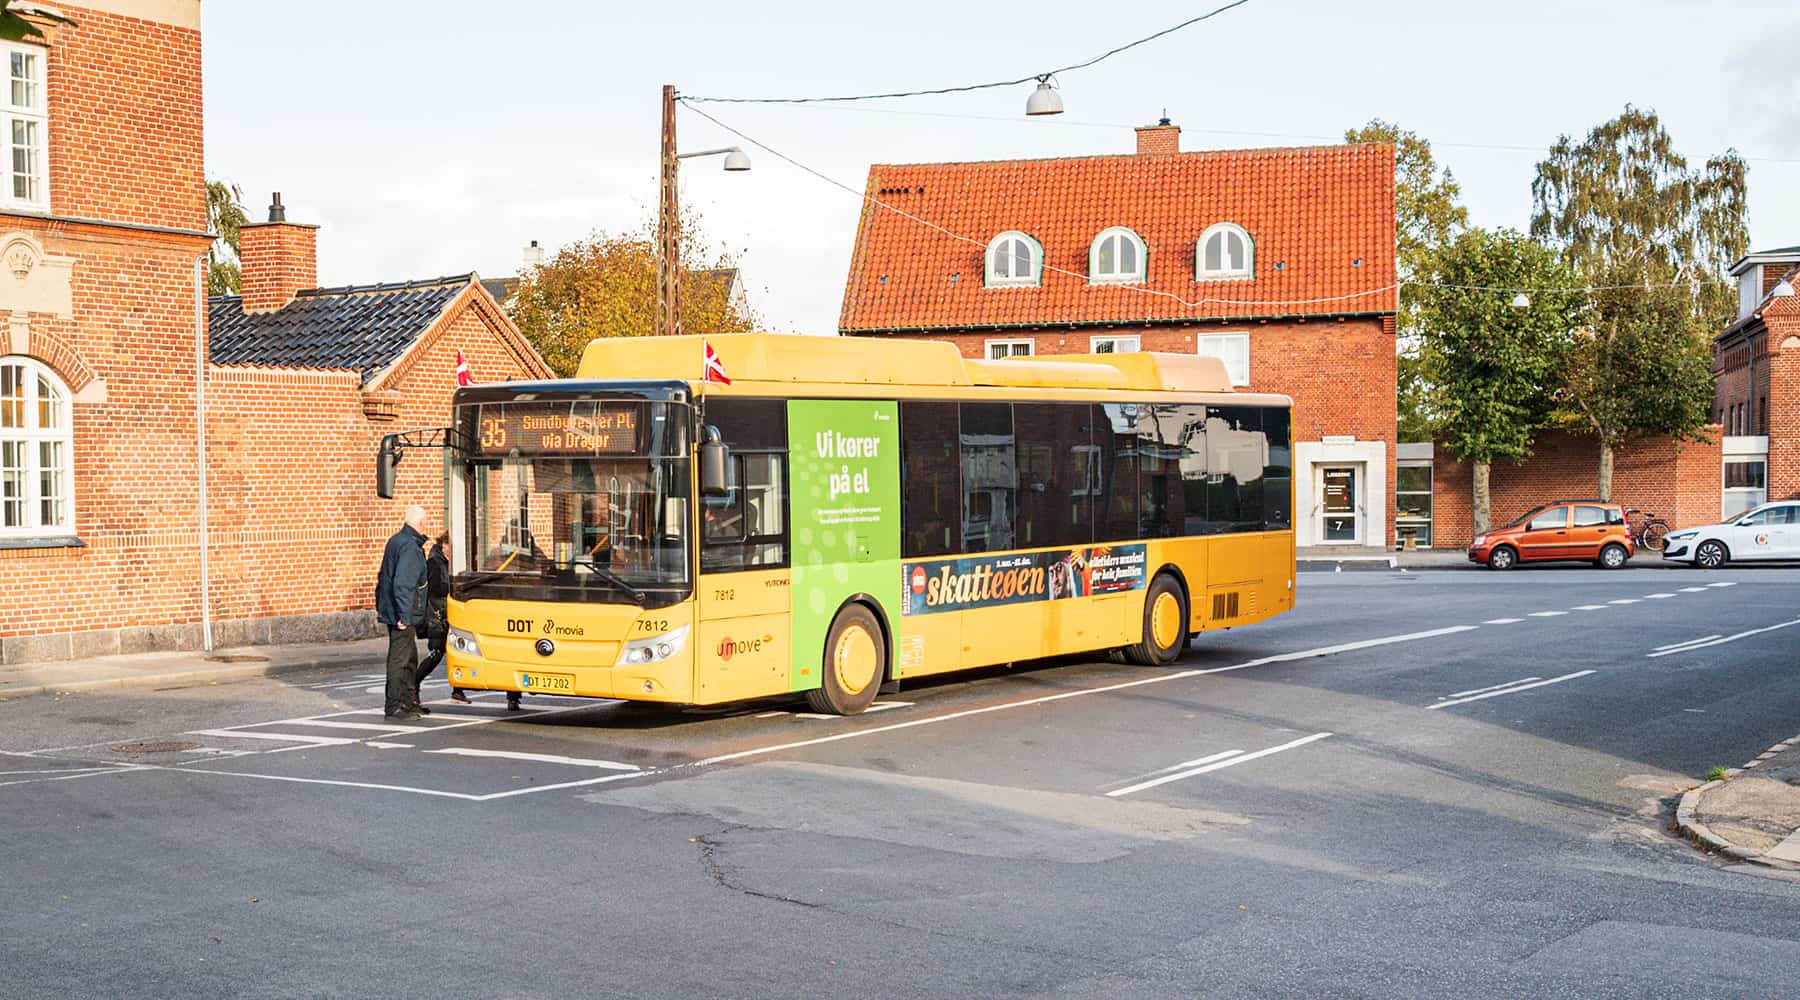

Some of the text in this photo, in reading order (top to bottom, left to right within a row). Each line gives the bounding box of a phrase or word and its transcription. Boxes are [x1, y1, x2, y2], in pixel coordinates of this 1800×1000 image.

[481, 418, 507, 448] 35
[542, 433, 562, 448] via
[816, 429, 833, 458] Vi
[830, 465, 870, 501] på el
[1336, 521, 1343, 531] 7
[926, 564, 1045, 606] skatteøen
[715, 589, 735, 601] 7812
[508, 619, 532, 632] DOT
[556, 624, 584, 636] movia
[637, 620, 668, 632] 7812
[717, 639, 761, 656] umove
[528, 677, 569, 689] DT 17 202
